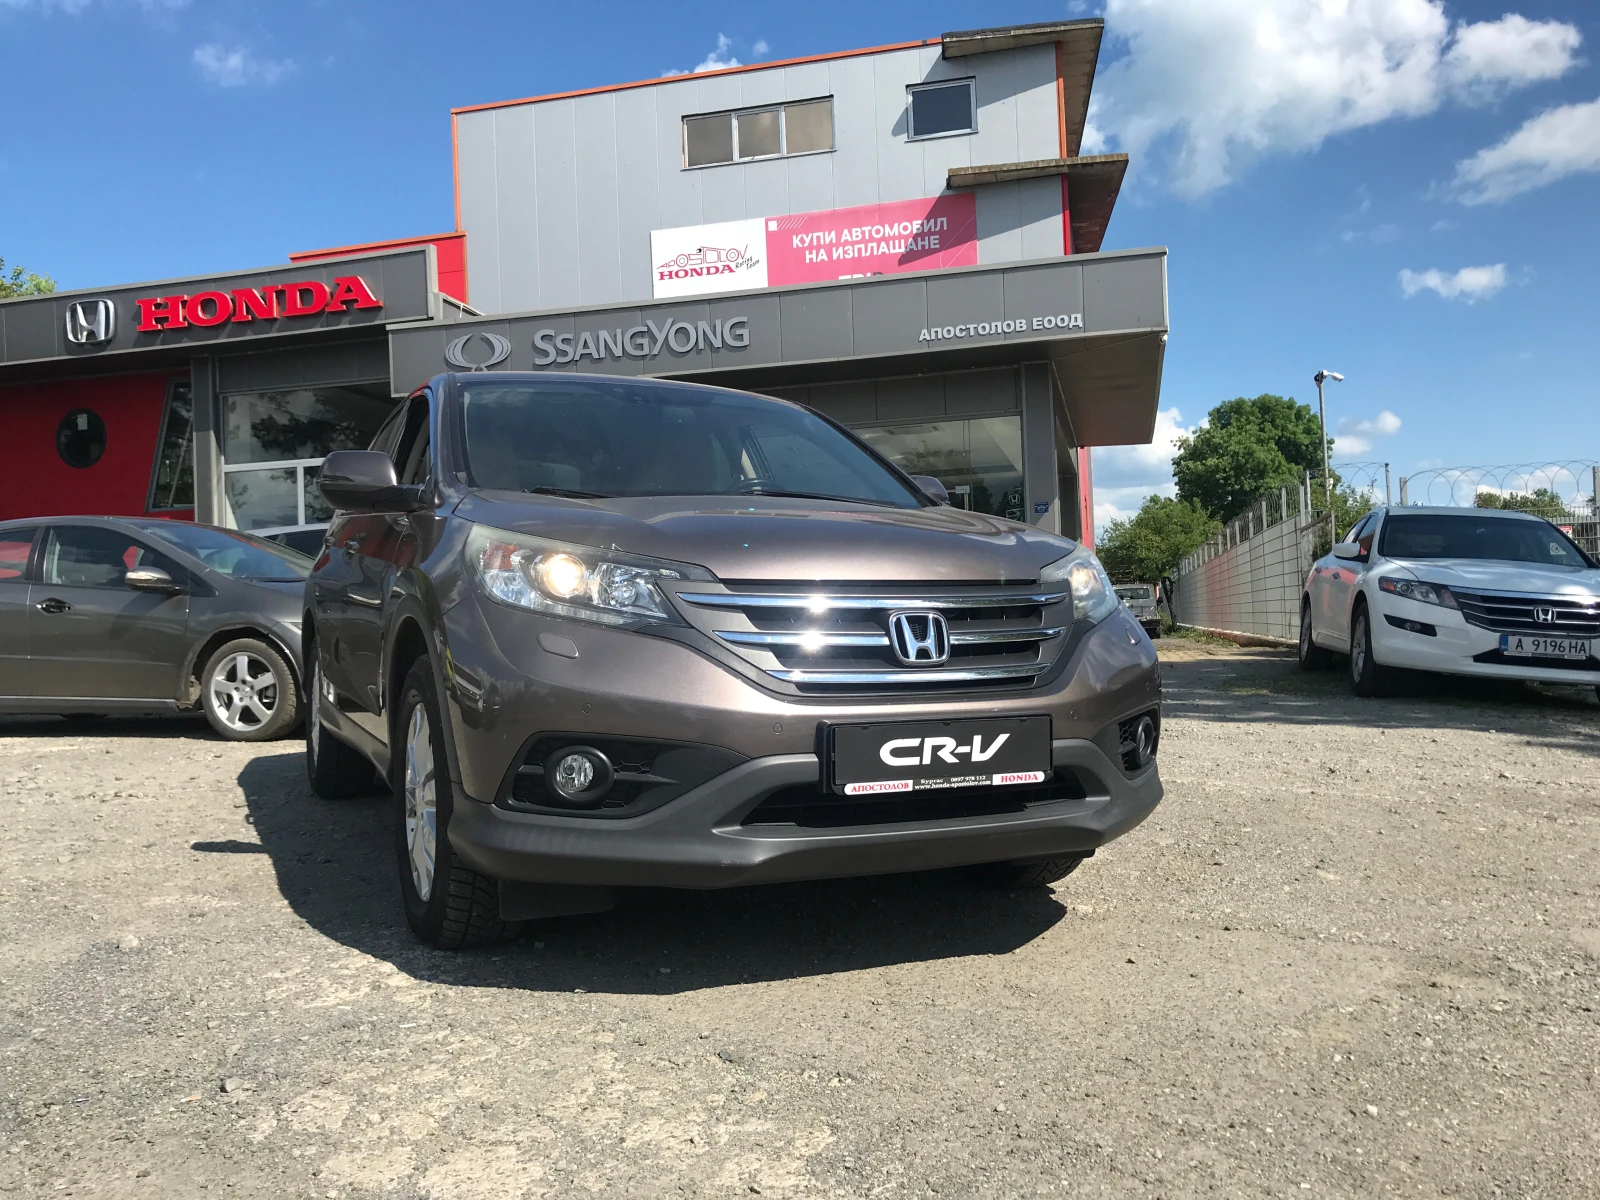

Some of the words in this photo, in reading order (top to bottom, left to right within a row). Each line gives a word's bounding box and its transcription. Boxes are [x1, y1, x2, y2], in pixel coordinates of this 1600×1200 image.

[792, 230, 836, 248] КУПИ
[840, 217, 948, 243] АВТОМОБИЛ
[735, 256, 753, 269] Racing
[805, 248, 828, 263] НА
[832, 235, 940, 260] ИЗПЛАЩАНЕ
[658, 264, 736, 281] HONDA
[136, 275, 384, 332] HONDA
[533, 316, 750, 365] SSANGYONG
[918, 319, 1027, 341] АПОСТОЛОВ
[1032, 313, 1083, 331] ЕООД
[1531, 639, 1566, 653] 9196
[879, 733, 1011, 766] CR-V
[851, 782, 909, 793] АПОСТОЛОВ
[1000, 773, 1039, 783] HONDA
